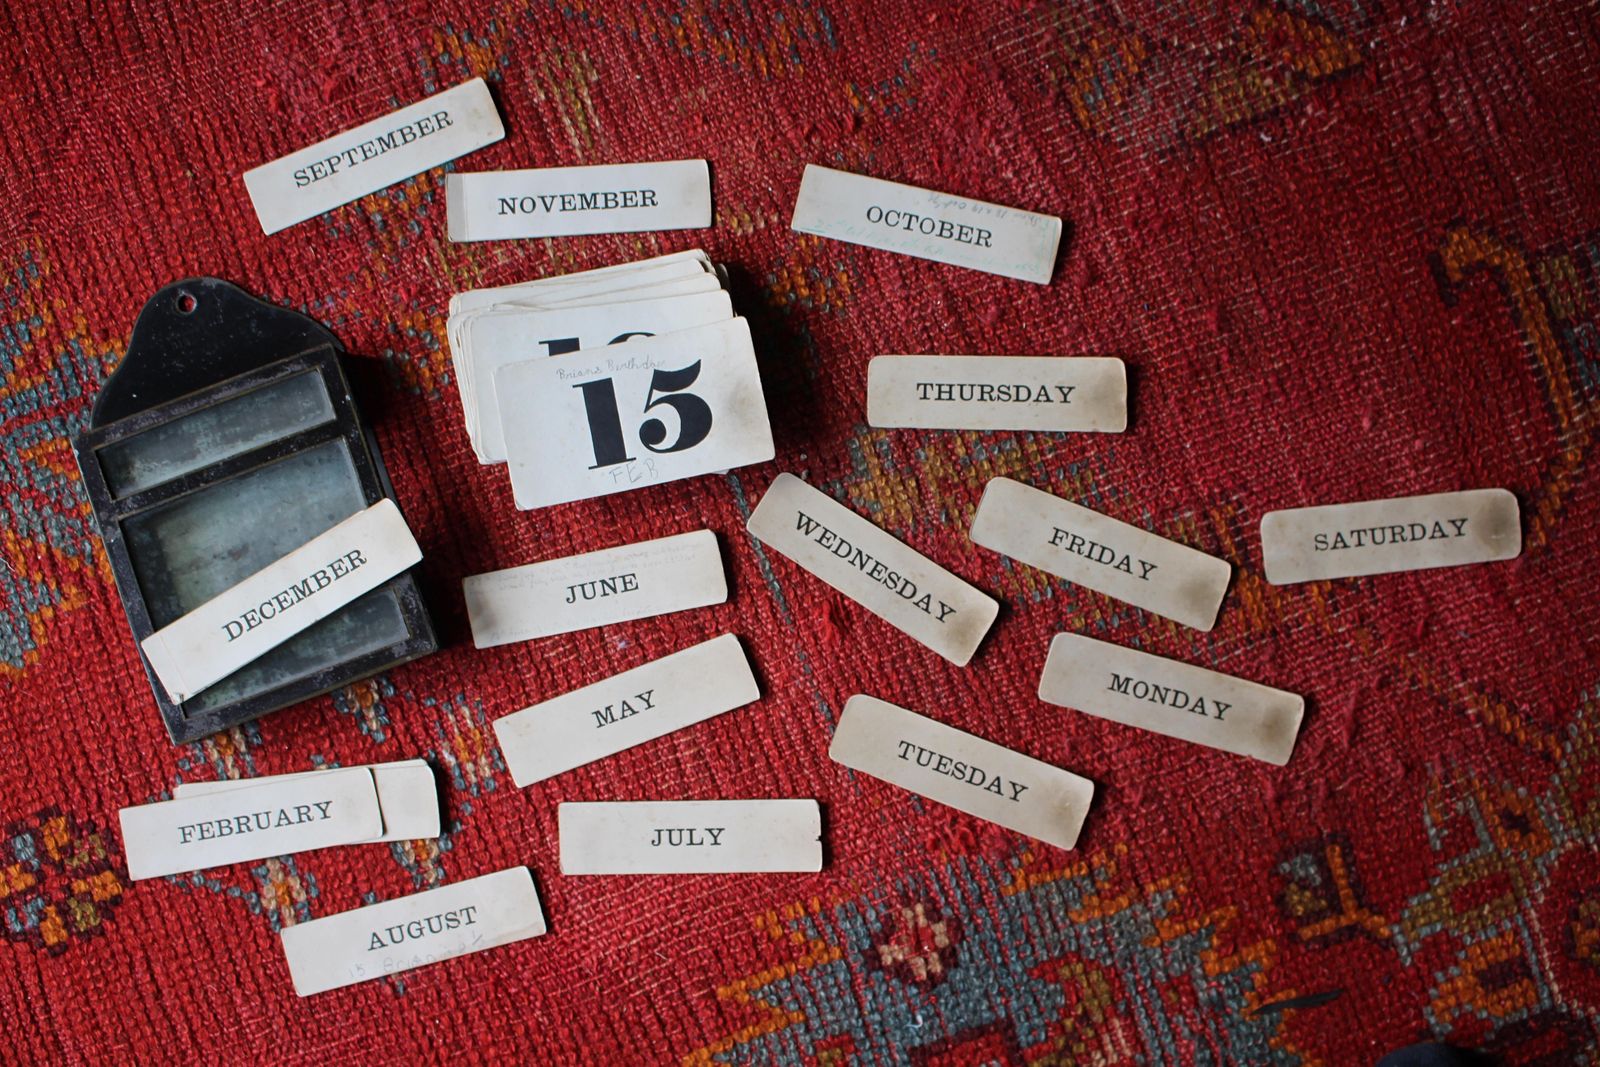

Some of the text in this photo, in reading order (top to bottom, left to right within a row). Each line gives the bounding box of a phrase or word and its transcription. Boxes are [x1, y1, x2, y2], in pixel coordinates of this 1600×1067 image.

[293, 110, 454, 188] SEPTEMBER
[497, 189, 659, 216] NOVEMBER
[866, 205, 993, 248] OCTOBER
[572, 359, 713, 470] 15
[916, 382, 1076, 404] THURSDAY
[609, 459, 660, 484] FEB
[1047, 526, 1158, 581] FRIDAY
[1314, 517, 1469, 552] SATURDAY
[565, 572, 639, 604] JUNE
[796, 510, 957, 624] WEDNESDAY
[221, 549, 368, 642] DECEMBER
[591, 689, 656, 729] MAY
[1107, 672, 1233, 721] MONDAY
[897, 739, 1029, 803] TUESDAY
[177, 800, 333, 845] FEBRUARY
[650, 827, 726, 847] JULY
[367, 905, 477, 952] AUGUST
